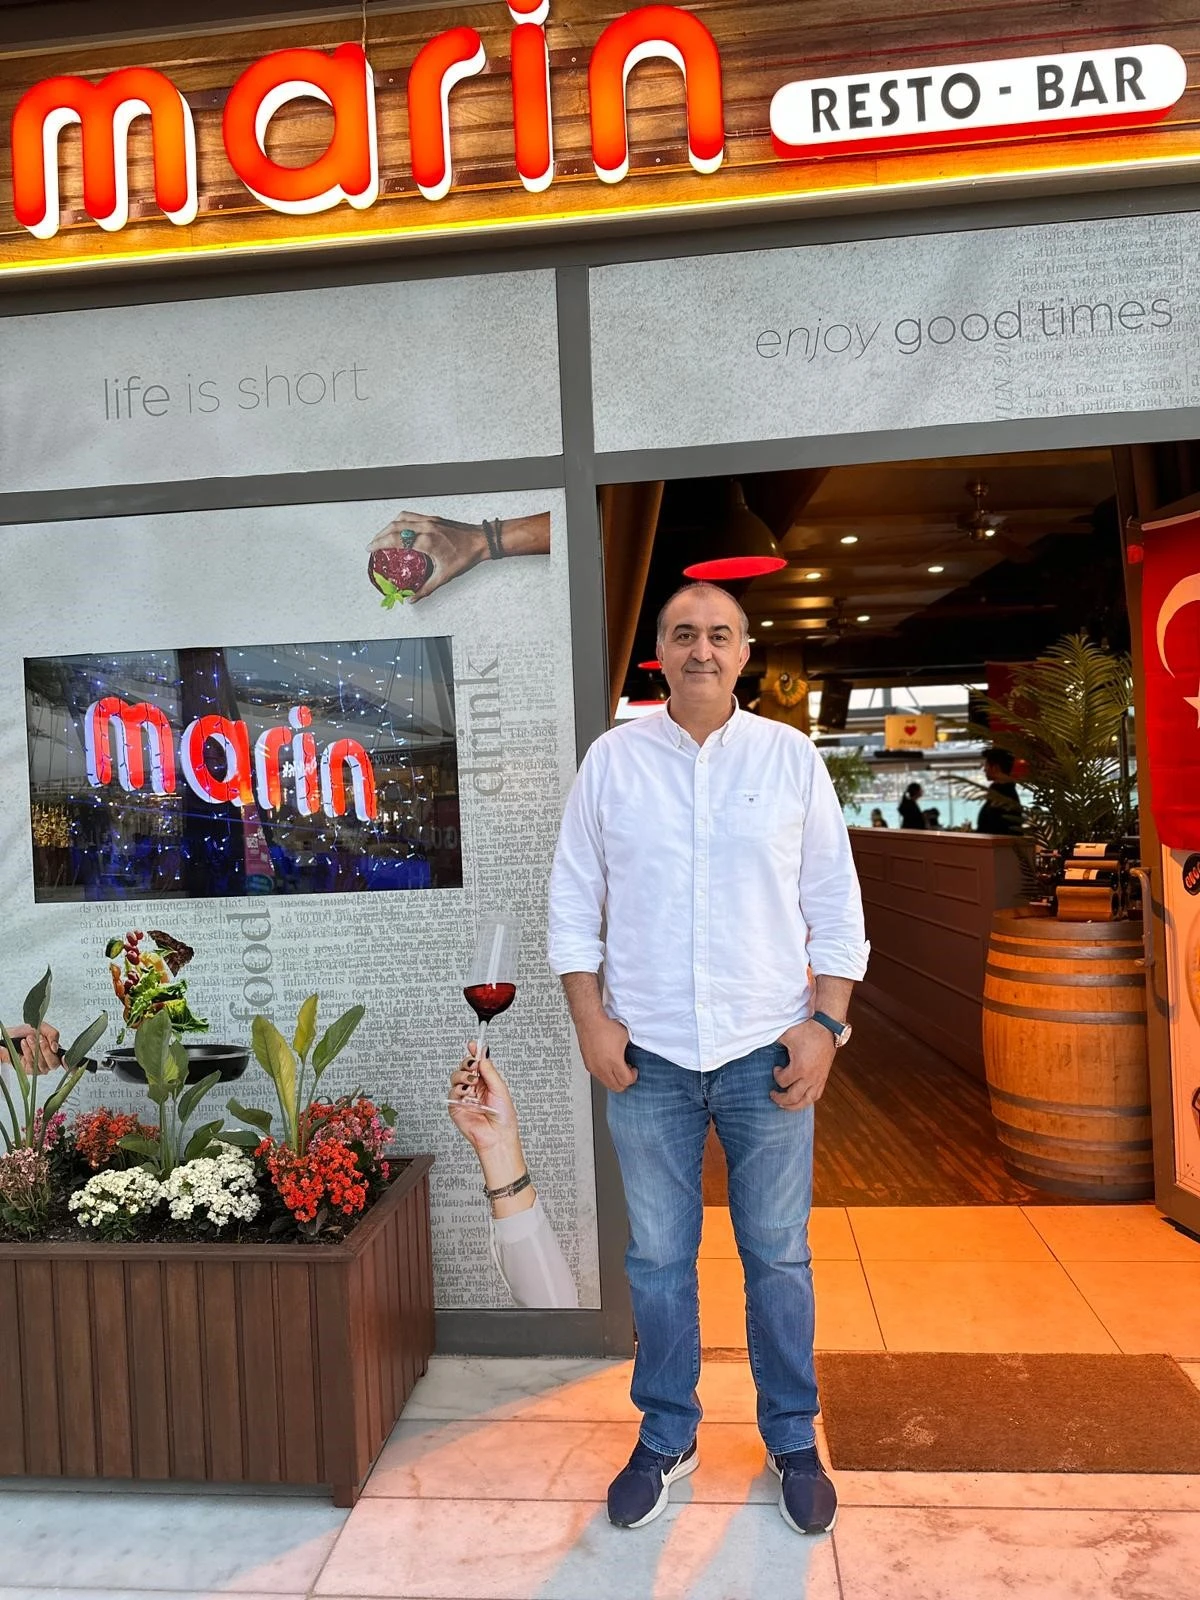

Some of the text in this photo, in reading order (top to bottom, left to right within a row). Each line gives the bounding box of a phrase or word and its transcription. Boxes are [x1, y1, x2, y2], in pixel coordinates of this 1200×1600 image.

[12, 0, 725, 239] marin
[810, 71, 982, 134] RESTO
[1035, 55, 1147, 111] BAR
[755, 297, 1173, 363] enjoy good times
[104, 361, 370, 421] life is short
[84, 696, 377, 822] marin
[454, 656, 504, 796] drink
[96, 917, 137, 928] dubbed
[226, 908, 275, 1024] food
